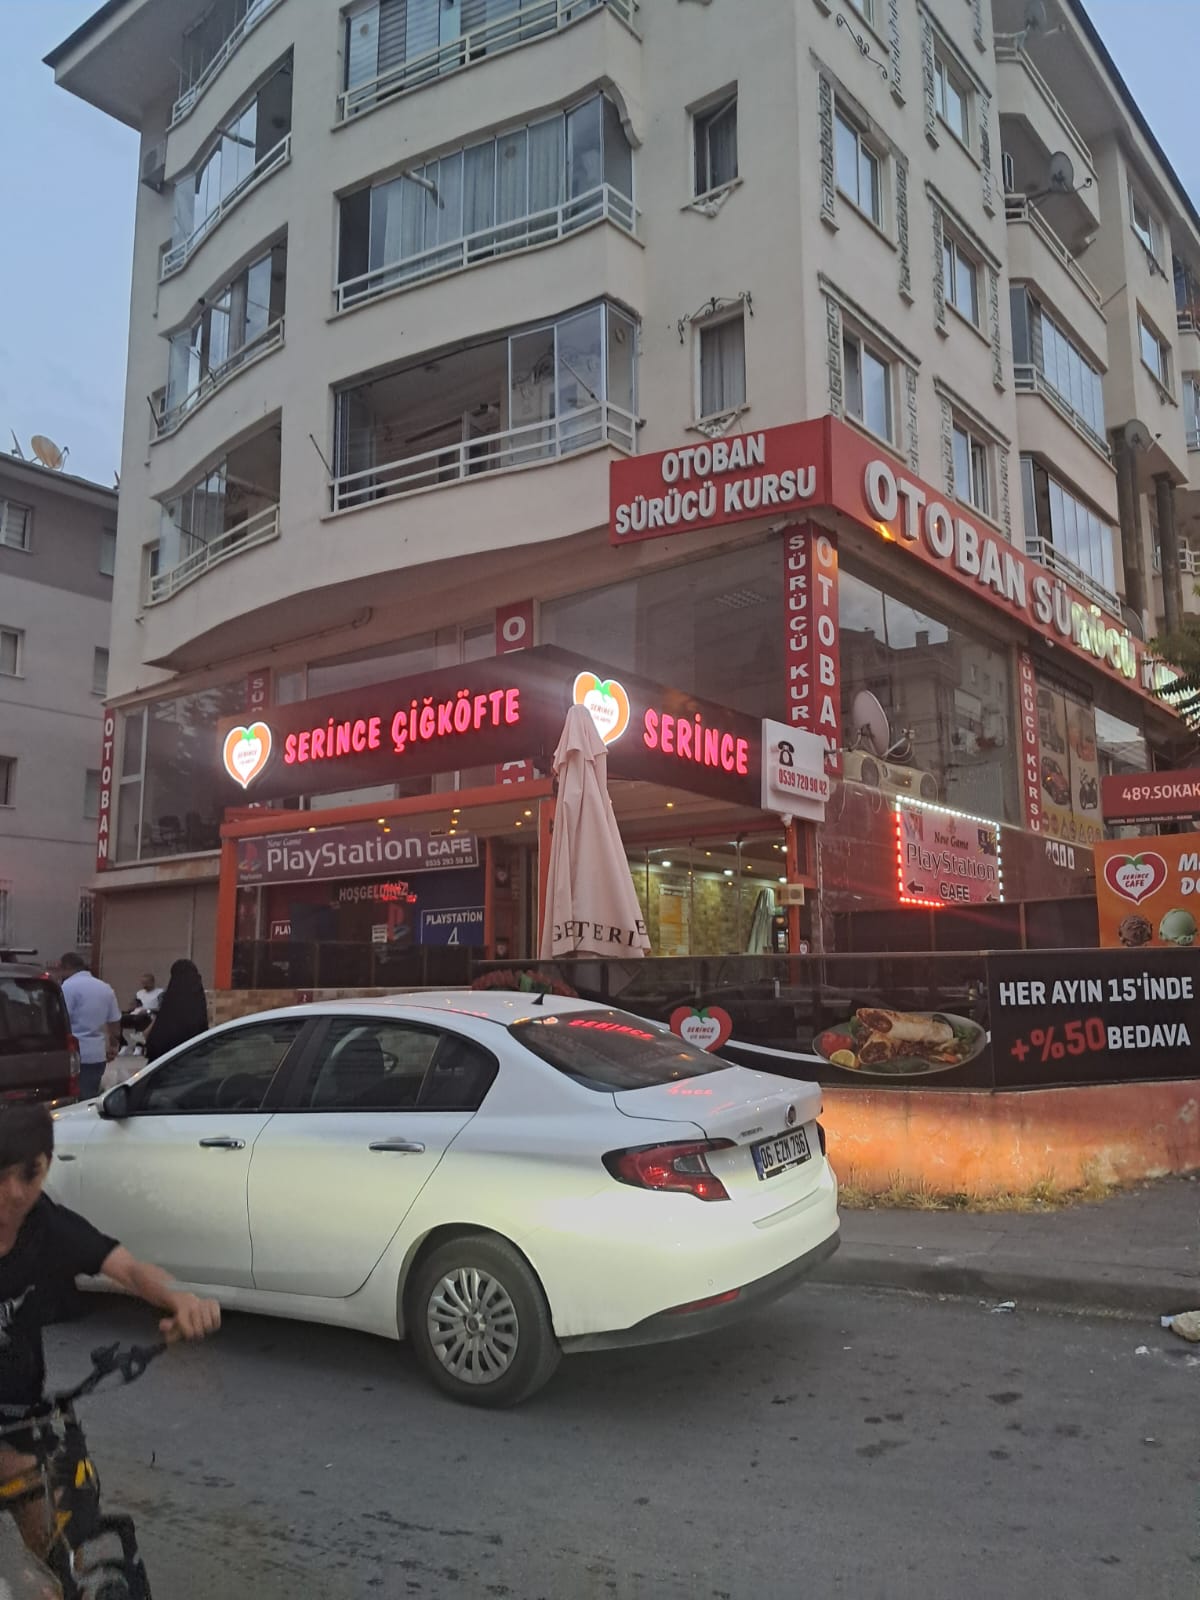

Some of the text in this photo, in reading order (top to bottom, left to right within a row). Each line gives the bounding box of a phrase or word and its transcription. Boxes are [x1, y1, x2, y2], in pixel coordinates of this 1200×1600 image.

[662, 433, 766, 483] OTOBAN
[615, 465, 817, 535] SÜRÜCÜ KURSU
[864, 459, 1026, 609] OTOBAN
[815, 534, 838, 769] OTOBAN
[283, 688, 521, 765] SERİNCE ÇİĞKÖFTE
[643, 707, 749, 775] SERİNCE
[98, 717, 114, 859] OTOBAN
[1026, 753, 1040, 832] KURSU
[266, 835, 472, 877] PlayStation CAFE
[906, 842, 996, 881] PlayStation
[939, 881, 972, 902] CAFE
[1124, 879, 1146, 889] CAFE
[447, 926, 460, 945] 4
[1000, 972, 1194, 1006] HER AYIN 15'İNDE
[1107, 1023, 1191, 1050] BEDAVA
[760, 1146, 774, 1169] 06
